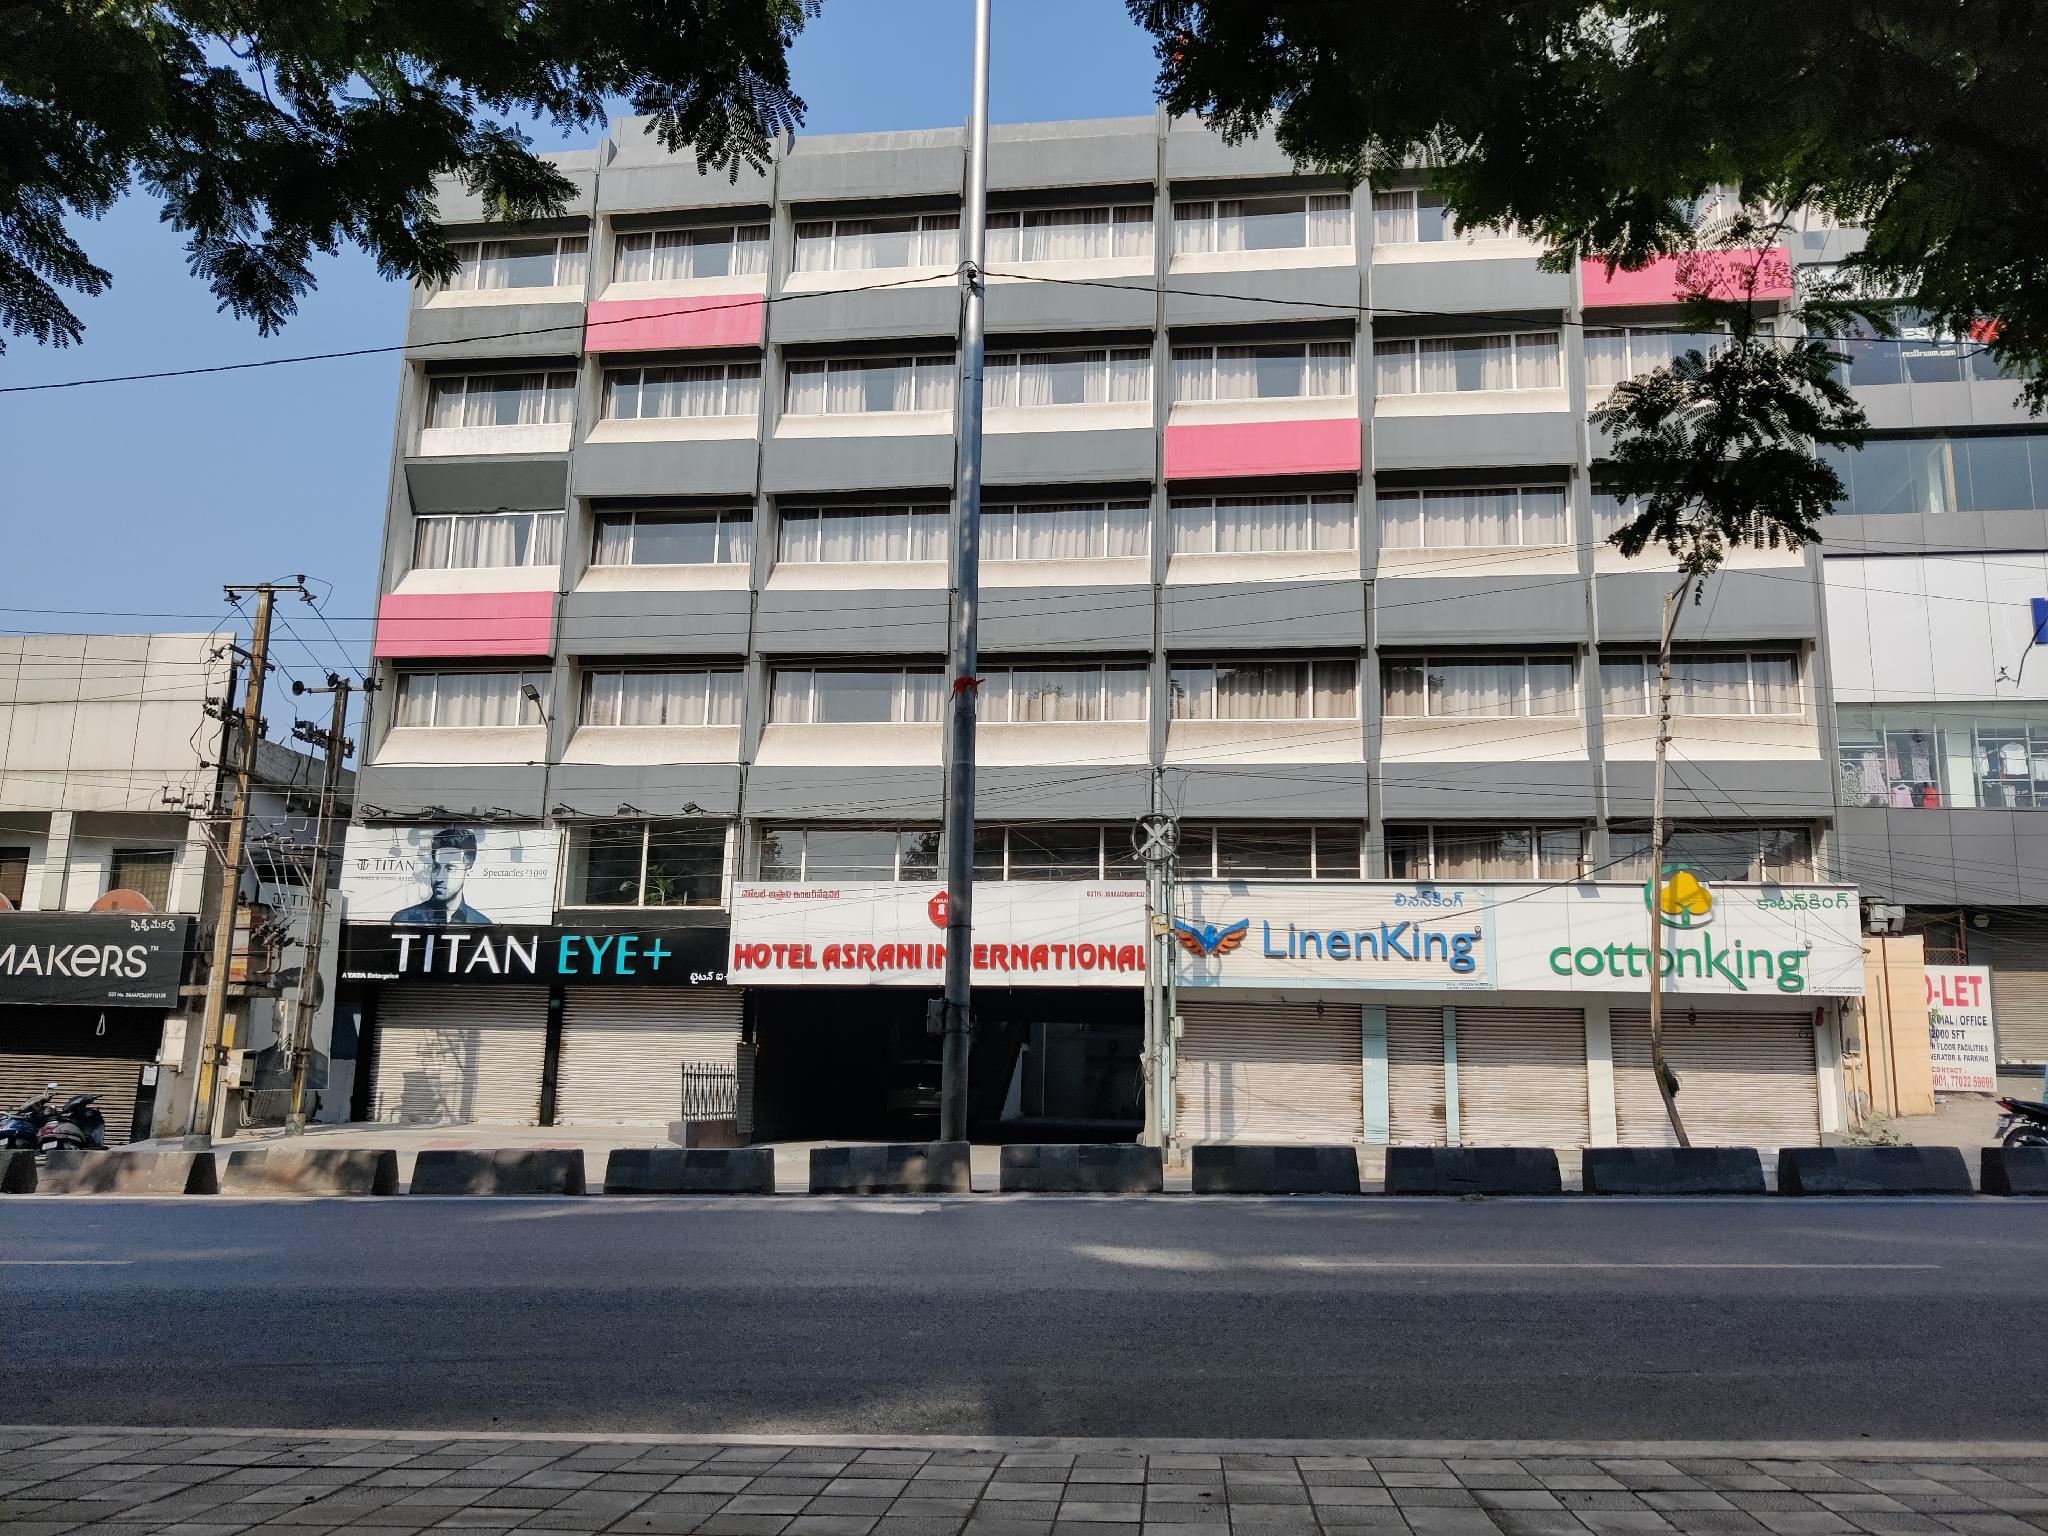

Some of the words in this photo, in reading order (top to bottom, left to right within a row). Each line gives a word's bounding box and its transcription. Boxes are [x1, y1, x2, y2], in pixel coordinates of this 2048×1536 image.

[375, 859, 416, 871] TITAN
[483, 867, 524, 879] Spectacles
[1263, 920, 1482, 974] LinenKing
[392, 934, 539, 974] TITAN
[558, 935, 672, 975] EYE+
[734, 943, 818, 972] HOTEL
[822, 943, 923, 973] ASRANI
[927, 943, 1146, 974] INERNATIONAL
[1549, 931, 1810, 992] cottonking
[367, 972, 400, 980] Enterprise
[1959, 1015, 1988, 1027] OFFICE
[1951, 1029, 1965, 1040] SFT
[1957, 1043, 1989, 1052] FACILITIES
[1931, 1066, 1962, 1074] CONTACT
